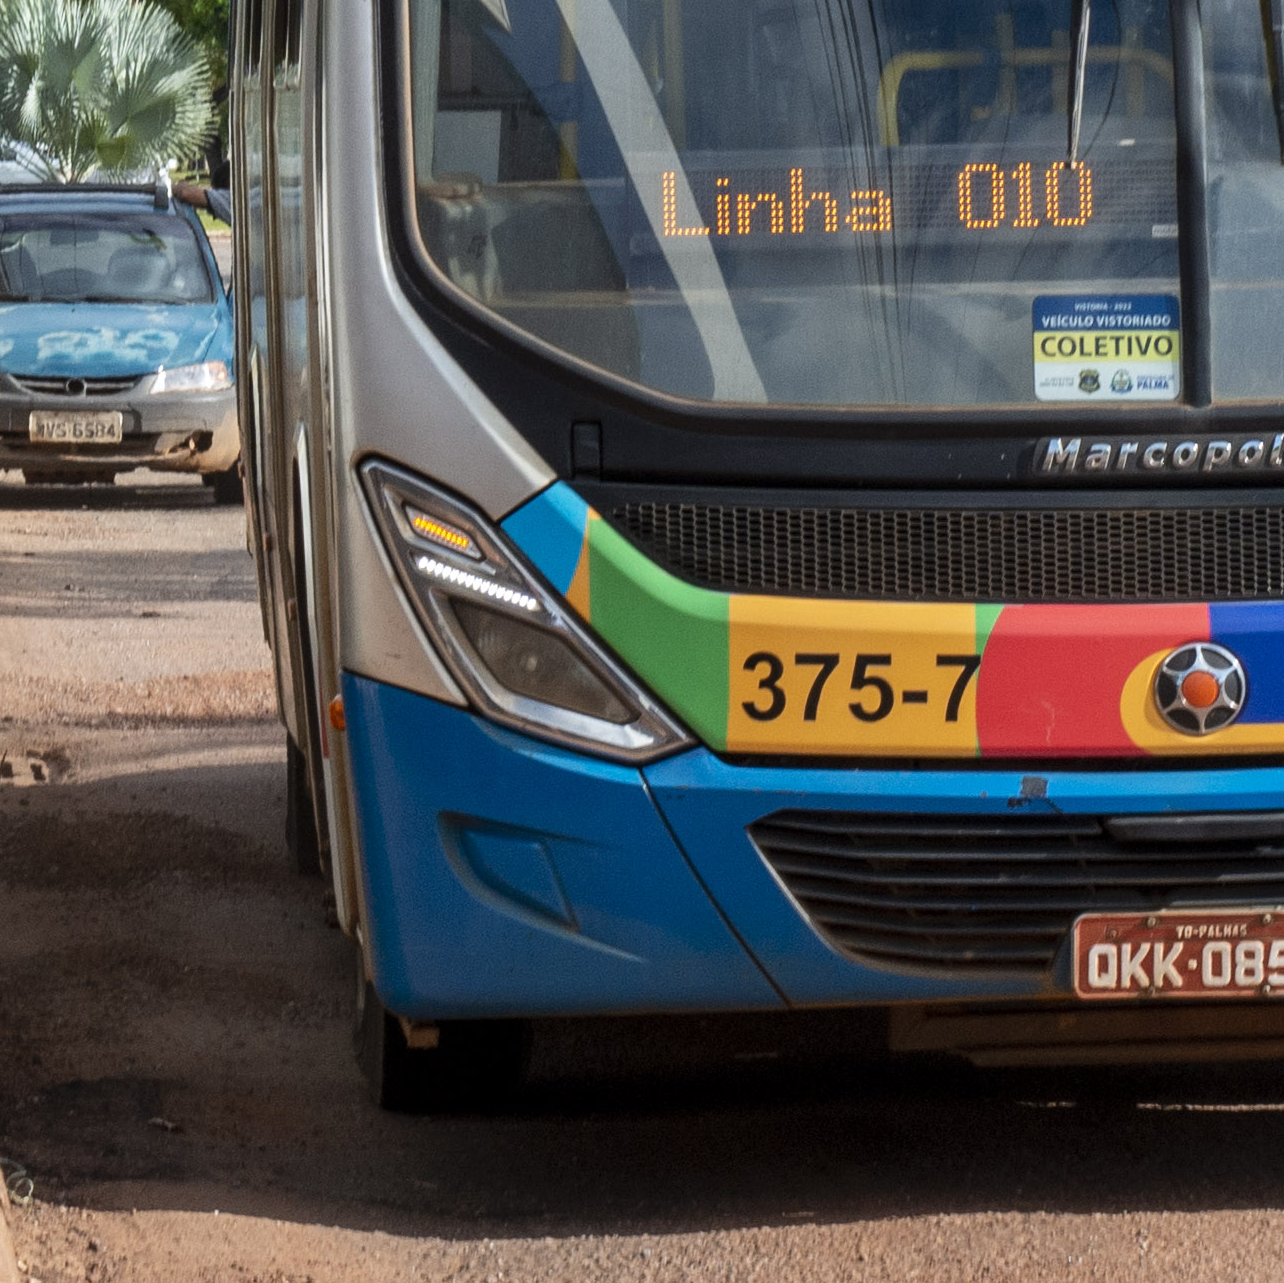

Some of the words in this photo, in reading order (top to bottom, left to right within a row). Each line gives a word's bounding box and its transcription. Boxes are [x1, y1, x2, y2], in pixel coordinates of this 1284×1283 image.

[662, 167, 892, 235] Linha
[958, 161, 1093, 228] 010
[1042, 312, 1094, 328] VEÍCULO
[1096, 313, 1171, 328] VISTORIADO
[1040, 335, 1173, 357] COLETIVO
[741, 651, 982, 722] 375-7
